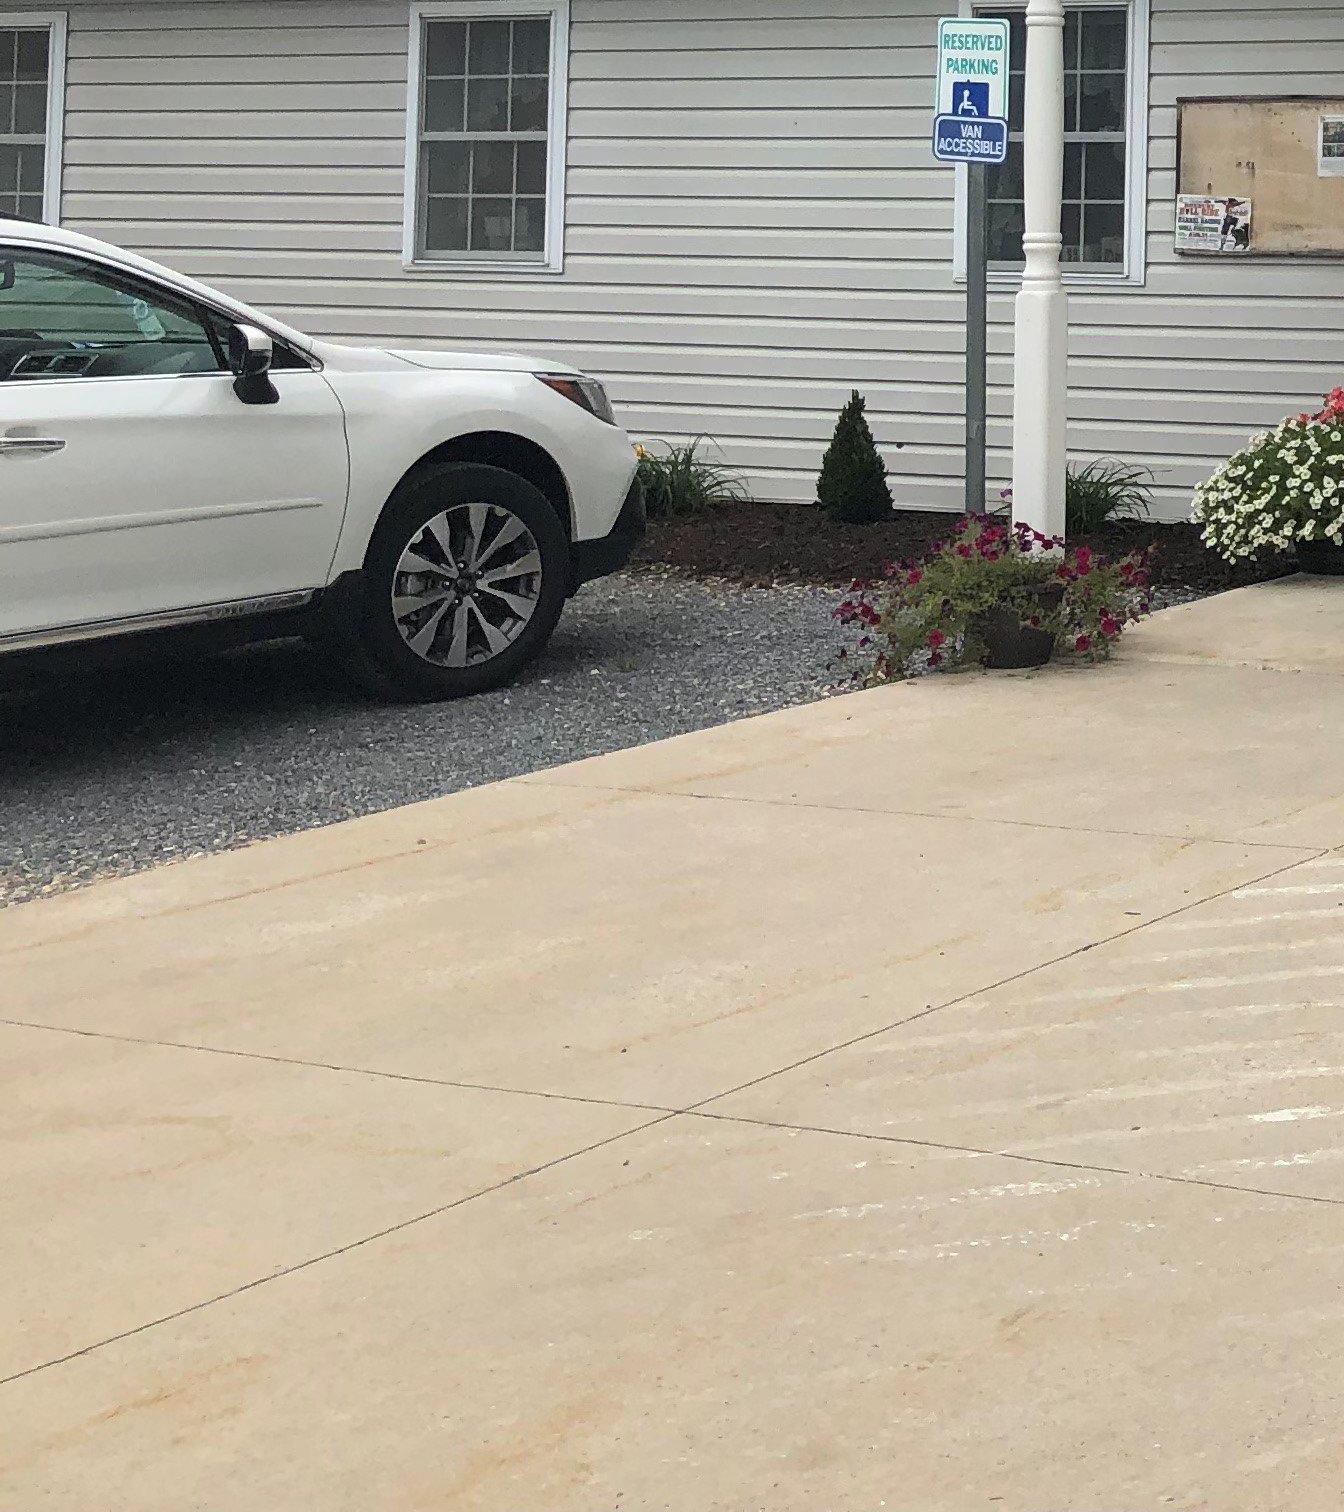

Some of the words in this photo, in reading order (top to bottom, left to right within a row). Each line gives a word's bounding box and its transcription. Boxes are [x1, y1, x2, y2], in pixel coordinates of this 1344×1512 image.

[943, 33, 1003, 51] RESERVED
[946, 57, 999, 76] PARKING
[960, 123, 983, 139] VAN
[938, 138, 1003, 156] ACCESSIBLE
